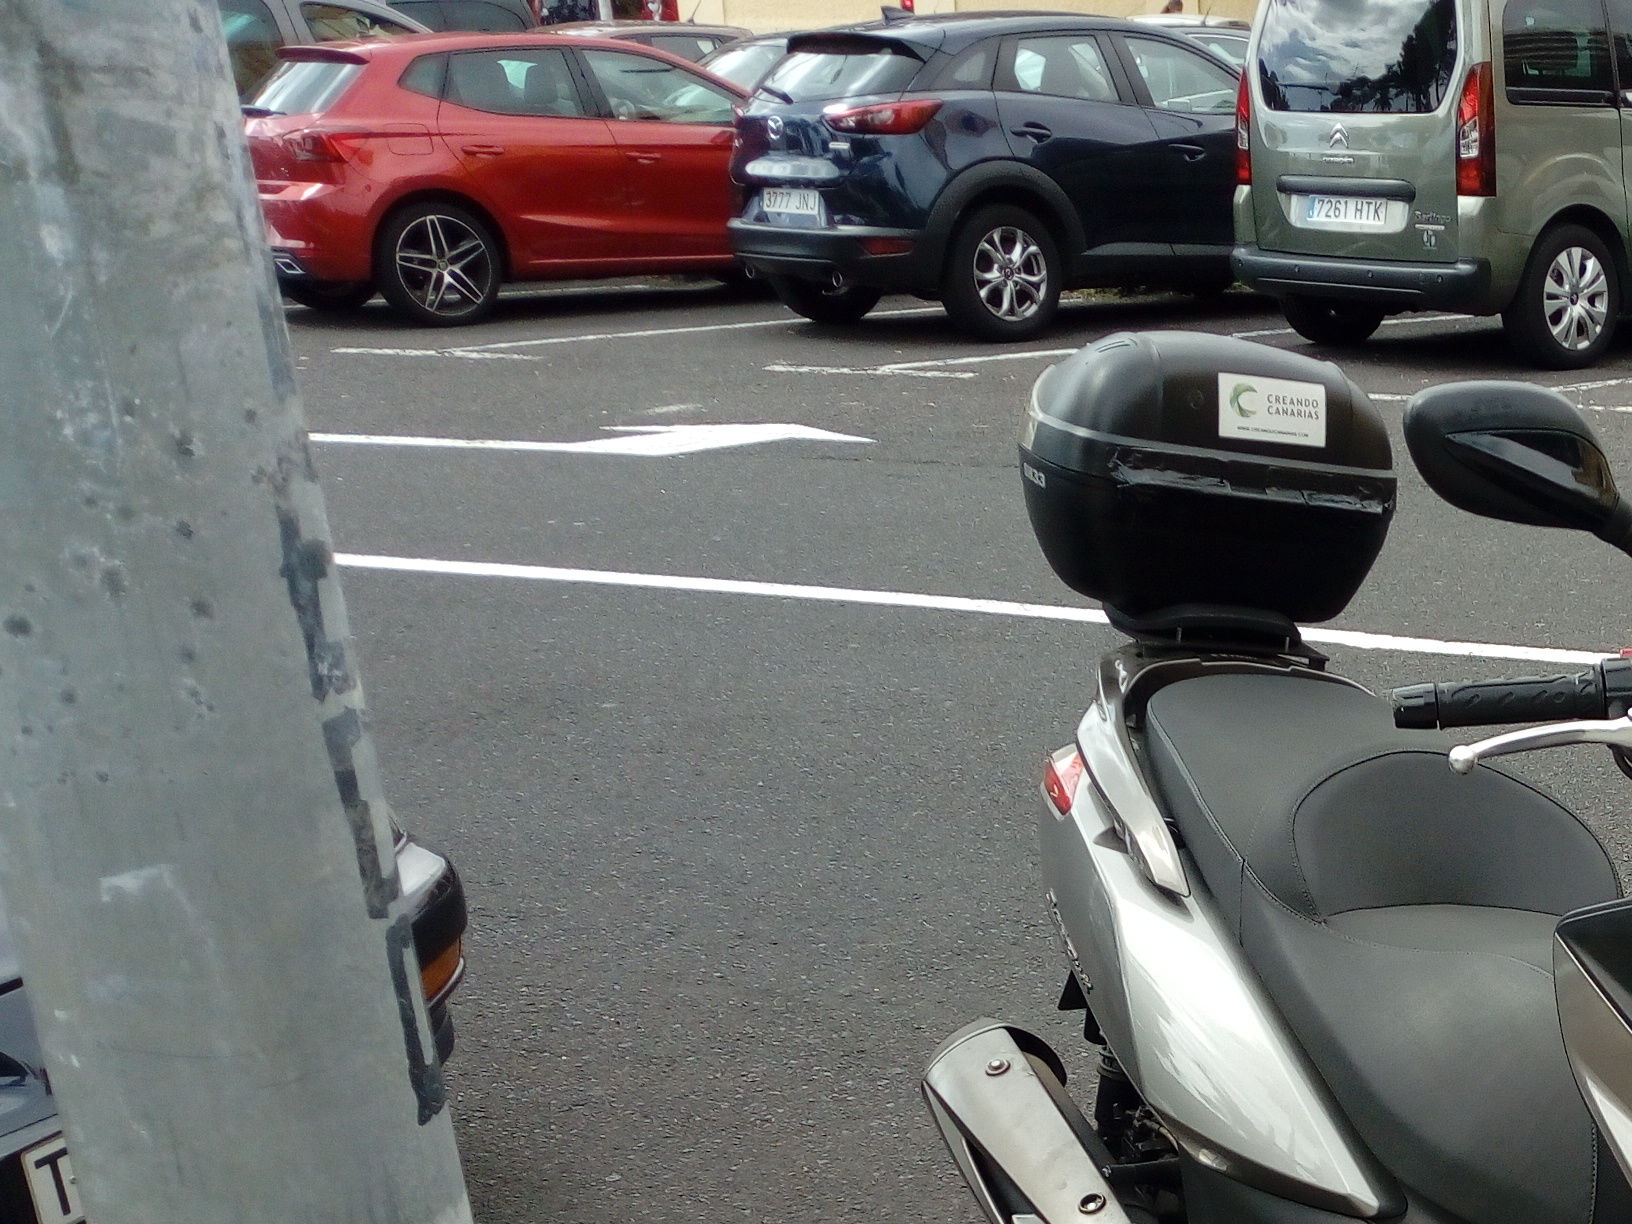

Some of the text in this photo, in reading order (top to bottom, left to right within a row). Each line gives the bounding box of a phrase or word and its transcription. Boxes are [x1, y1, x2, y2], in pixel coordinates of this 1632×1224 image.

[765, 191, 791, 208] 3777
[1317, 200, 1383, 221] 7261 HTK
[1267, 394, 1319, 408] CREANDO
[1267, 405, 1319, 420] CANARIAS
